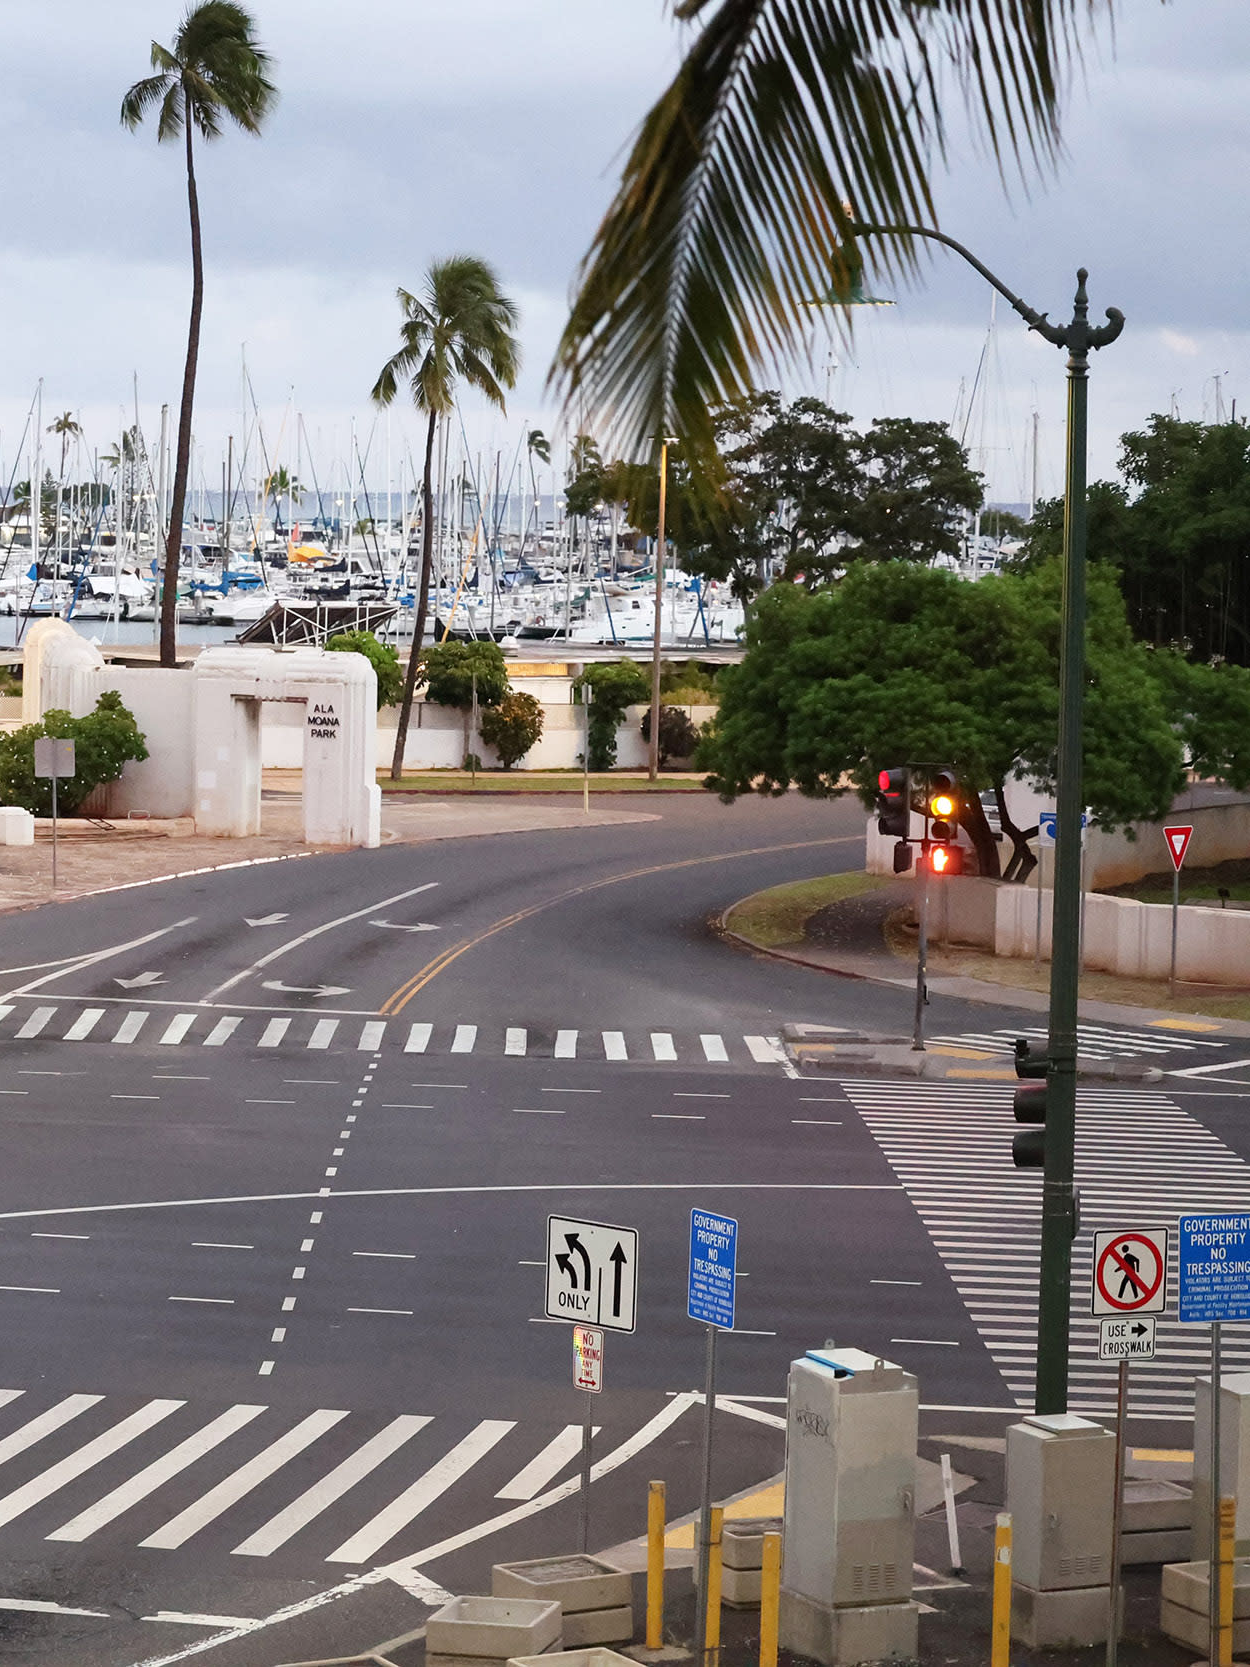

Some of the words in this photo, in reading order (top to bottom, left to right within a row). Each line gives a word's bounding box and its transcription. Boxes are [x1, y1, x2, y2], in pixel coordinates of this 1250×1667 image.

[314, 704, 334, 714] ALA
[307, 716, 340, 726] MOANA
[311, 729, 336, 739] PARK
[694, 1214, 735, 1236] GOVERNMENT
[697, 1230, 730, 1250] PROPERTY
[1190, 1232, 1246, 1246] PROPERTY
[708, 1248, 718, 1261] NO
[1210, 1247, 1227, 1260] NO
[694, 1258, 732, 1281] TRESPASSING
[1186, 1261, 1250, 1275] TRESPASSING
[558, 1291, 590, 1311] ONLY
[1108, 1324, 1127, 1337] USE
[583, 1333, 594, 1346] NO
[1103, 1340, 1152, 1355] CROSSWALK
